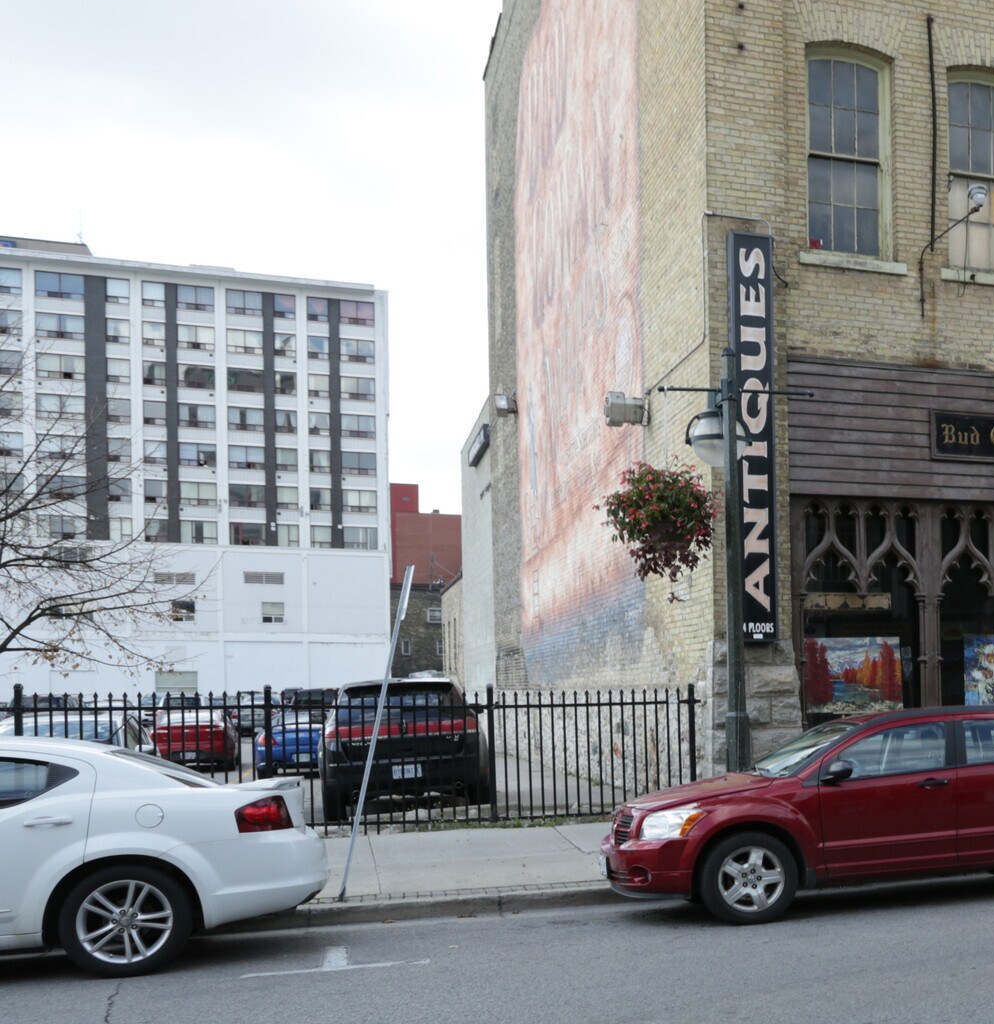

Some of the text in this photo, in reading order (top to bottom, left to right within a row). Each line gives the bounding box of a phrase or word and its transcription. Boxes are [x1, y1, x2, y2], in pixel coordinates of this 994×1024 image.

[739, 247, 771, 612] ANTIQUES
[941, 424, 980, 445] Bud
[748, 622, 774, 633] FLOORS
